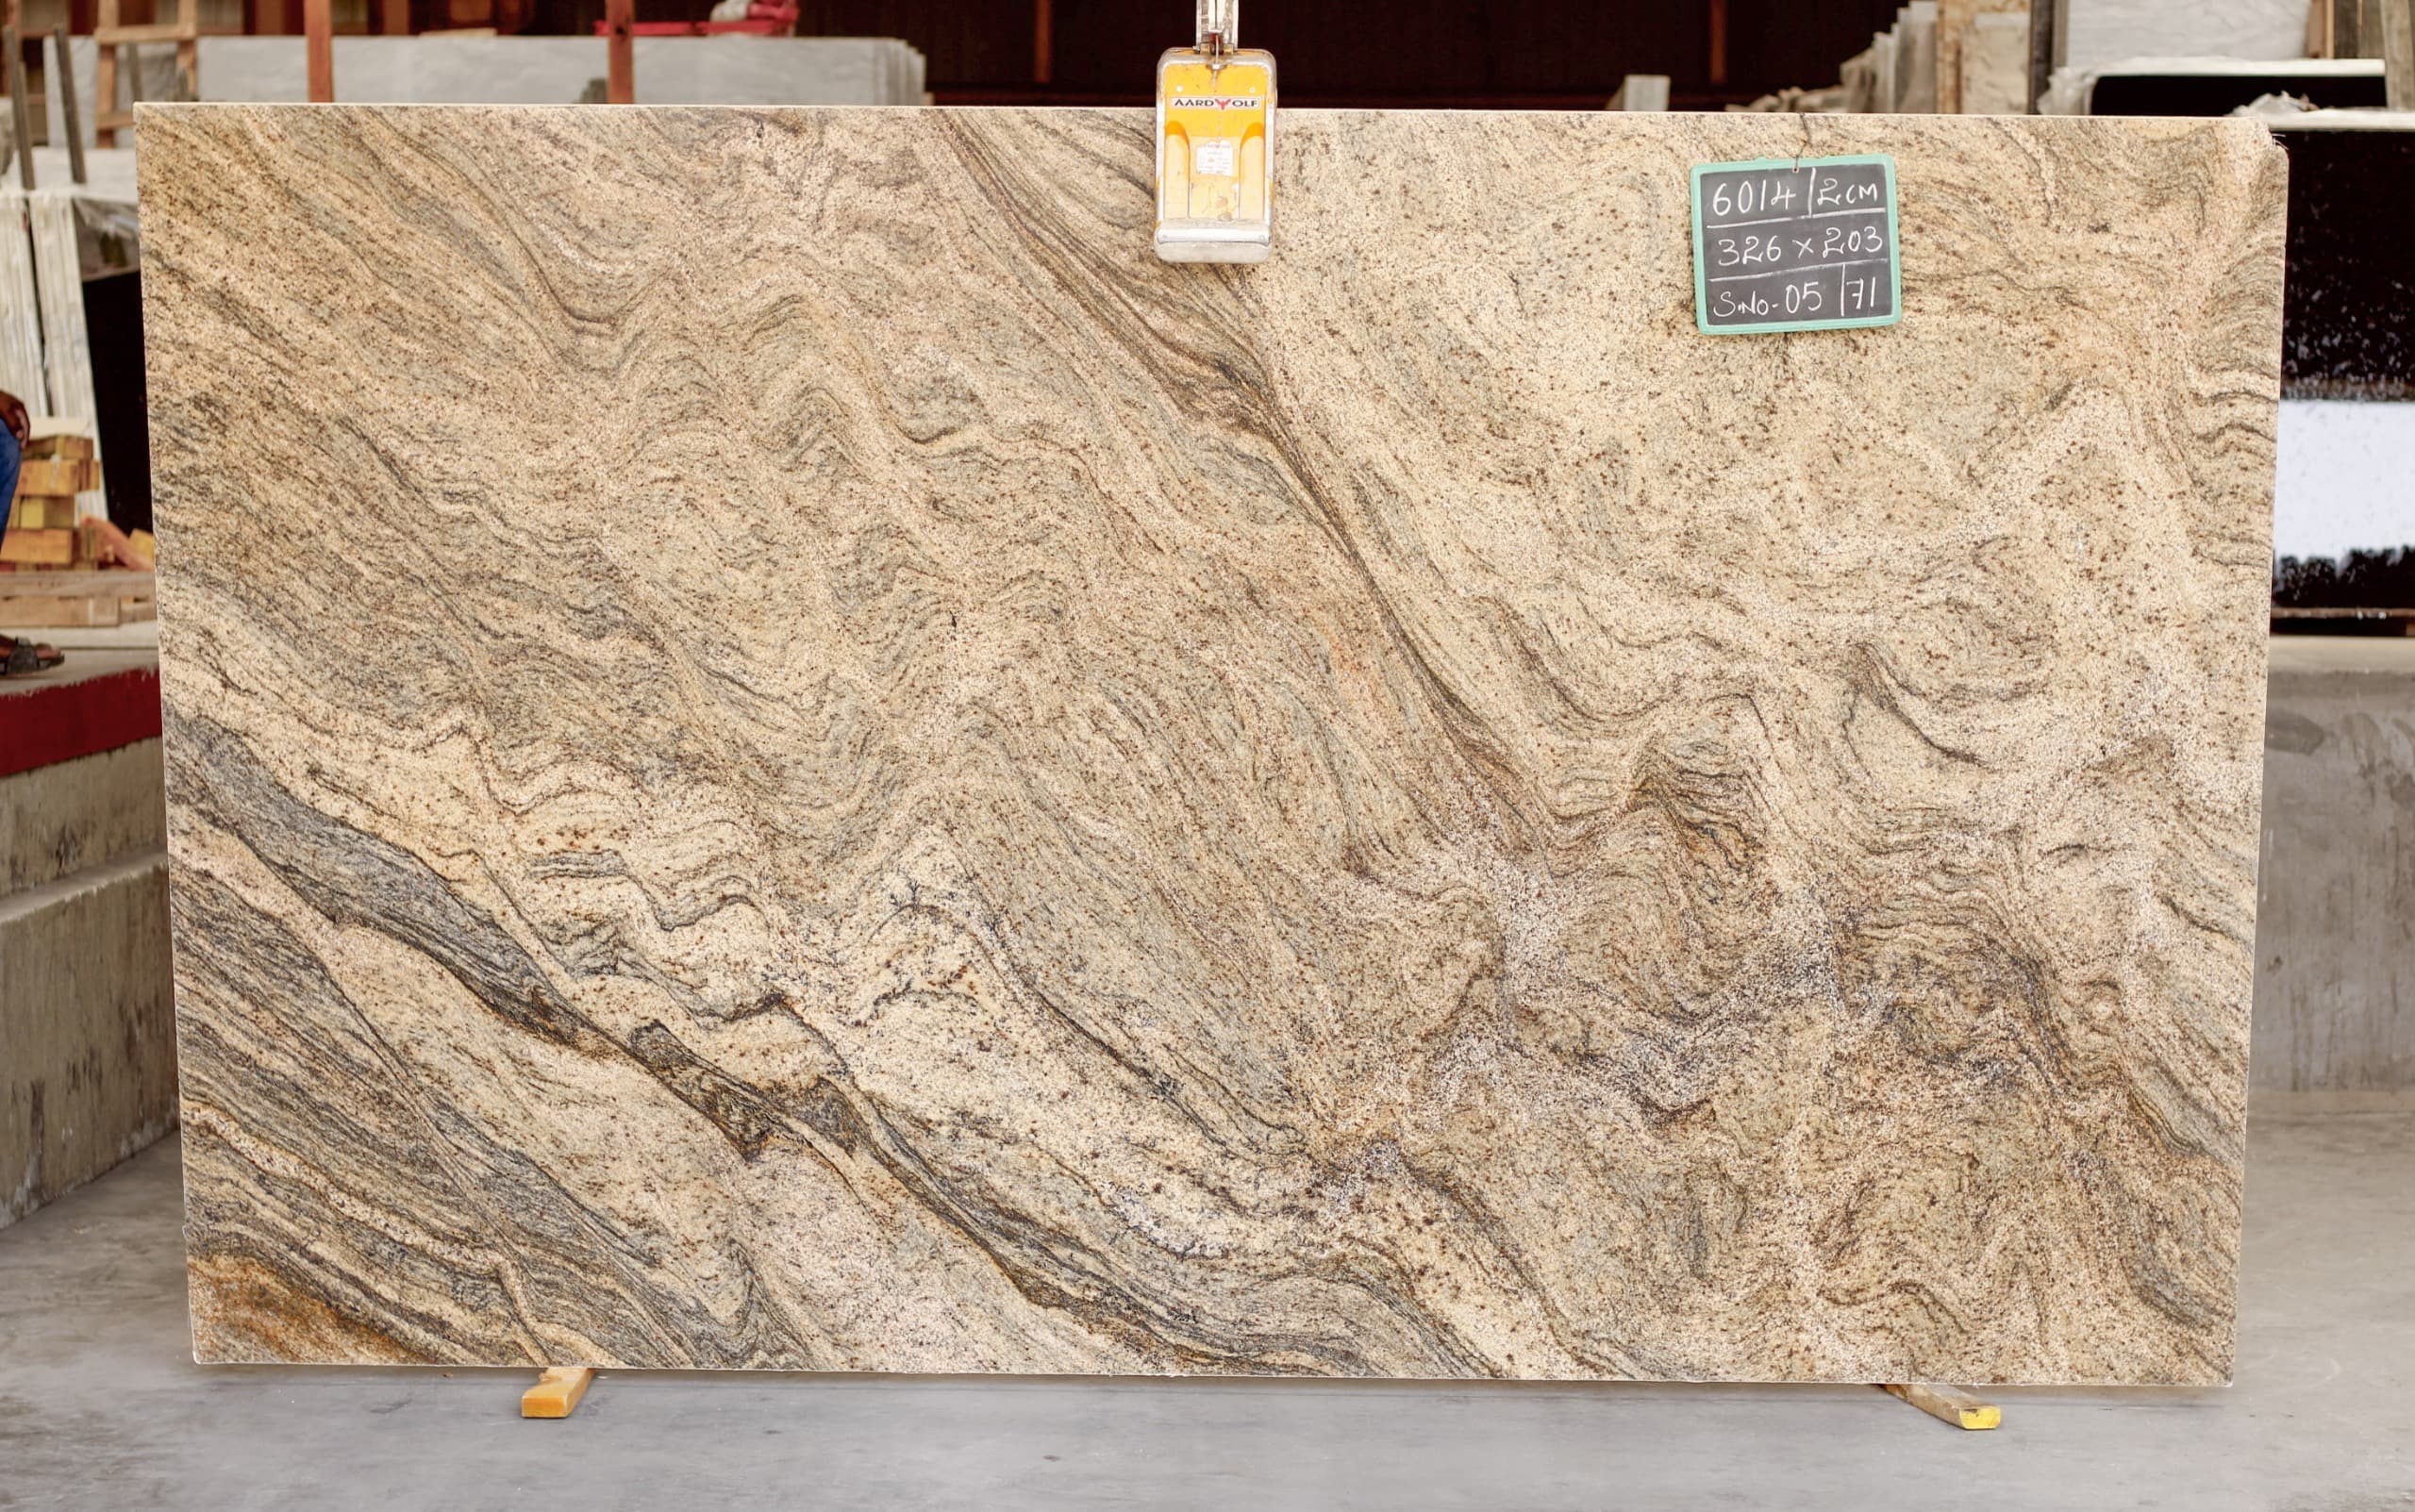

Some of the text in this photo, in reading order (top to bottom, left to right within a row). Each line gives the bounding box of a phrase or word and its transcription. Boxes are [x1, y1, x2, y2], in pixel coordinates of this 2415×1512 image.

[1712, 179, 1796, 216] 6014
[1718, 236, 1782, 266] 326
[1822, 226, 1883, 258] 203
[1846, 276, 1876, 309] 71
